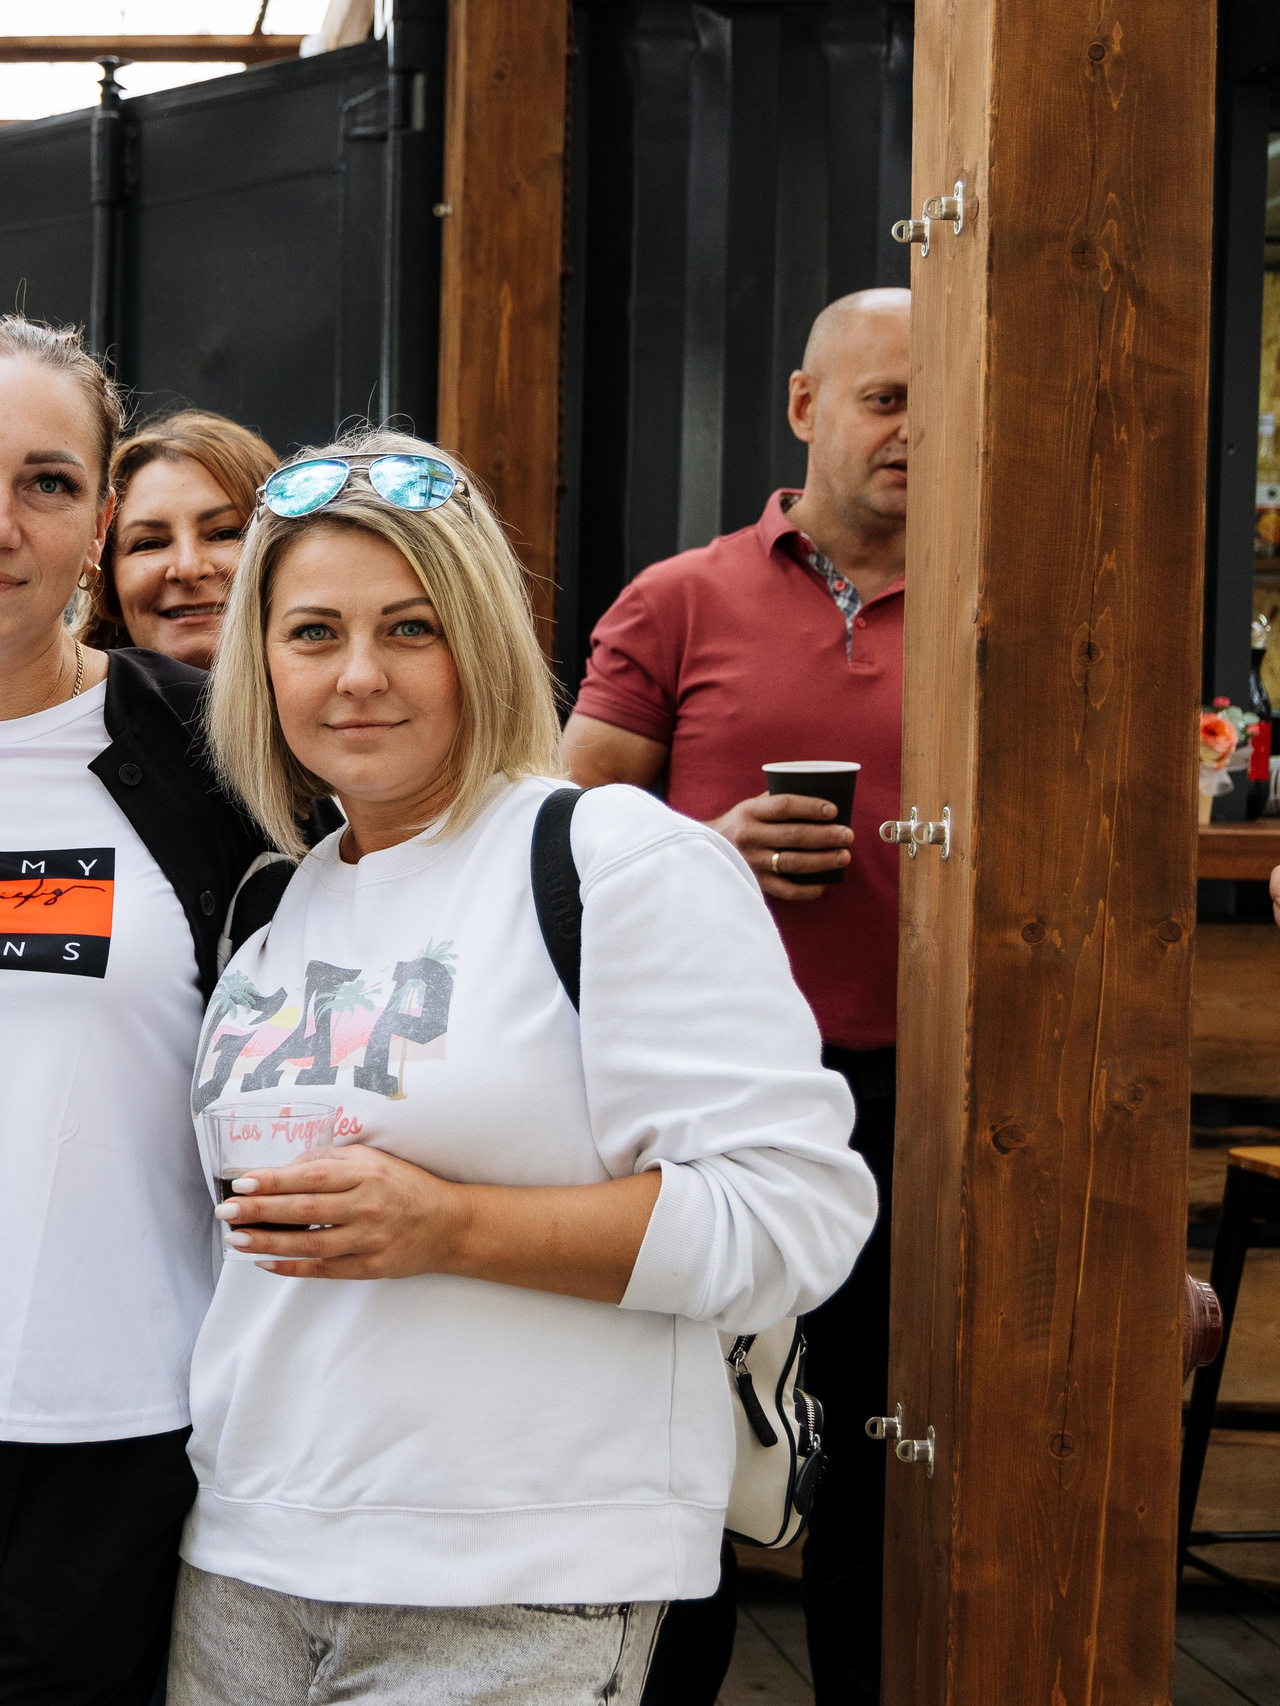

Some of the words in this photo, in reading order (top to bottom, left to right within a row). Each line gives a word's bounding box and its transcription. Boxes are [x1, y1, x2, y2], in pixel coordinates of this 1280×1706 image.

[191, 957, 455, 1117] GAP
[229, 1109, 263, 1144] Los
[271, 1103, 363, 1150] Angeles
